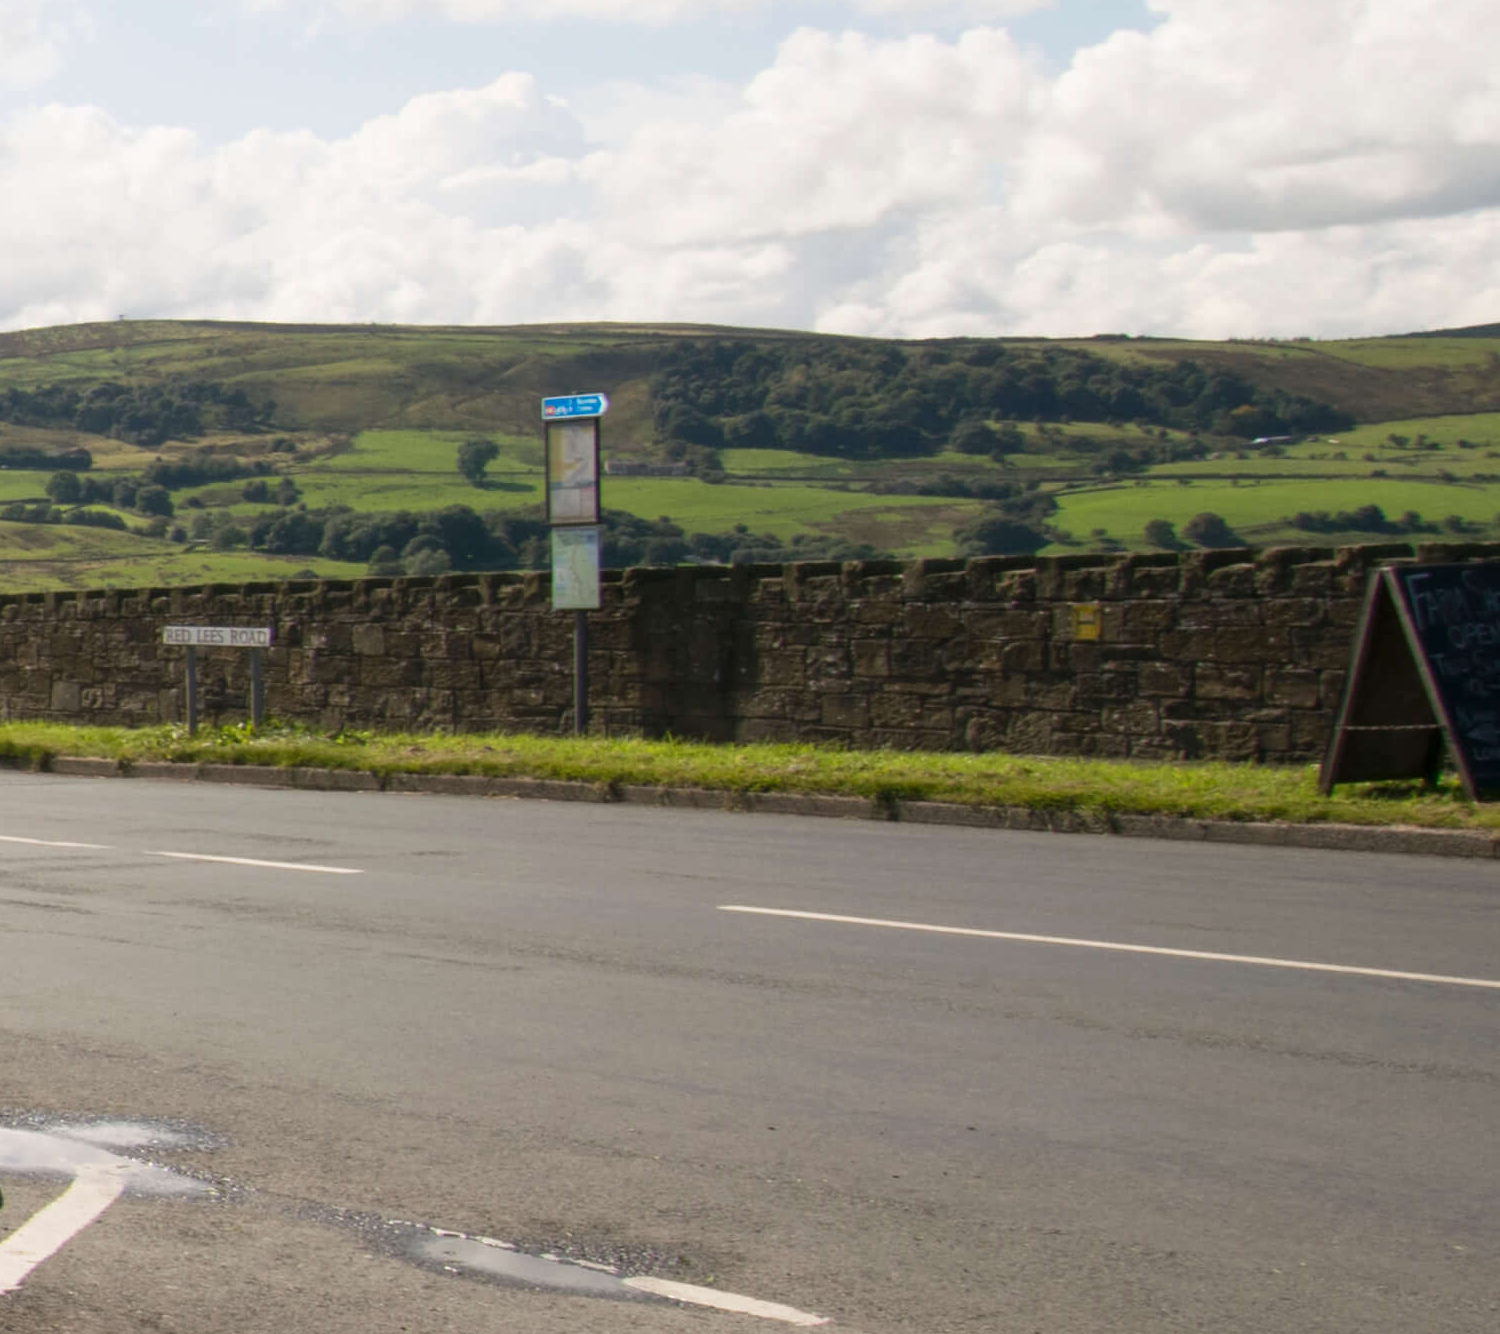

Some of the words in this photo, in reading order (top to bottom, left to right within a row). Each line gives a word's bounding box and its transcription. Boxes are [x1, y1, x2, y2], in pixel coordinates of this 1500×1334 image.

[166, 628, 190, 643] RED
[196, 628, 224, 644] LEES
[230, 628, 266, 645] ROAD
